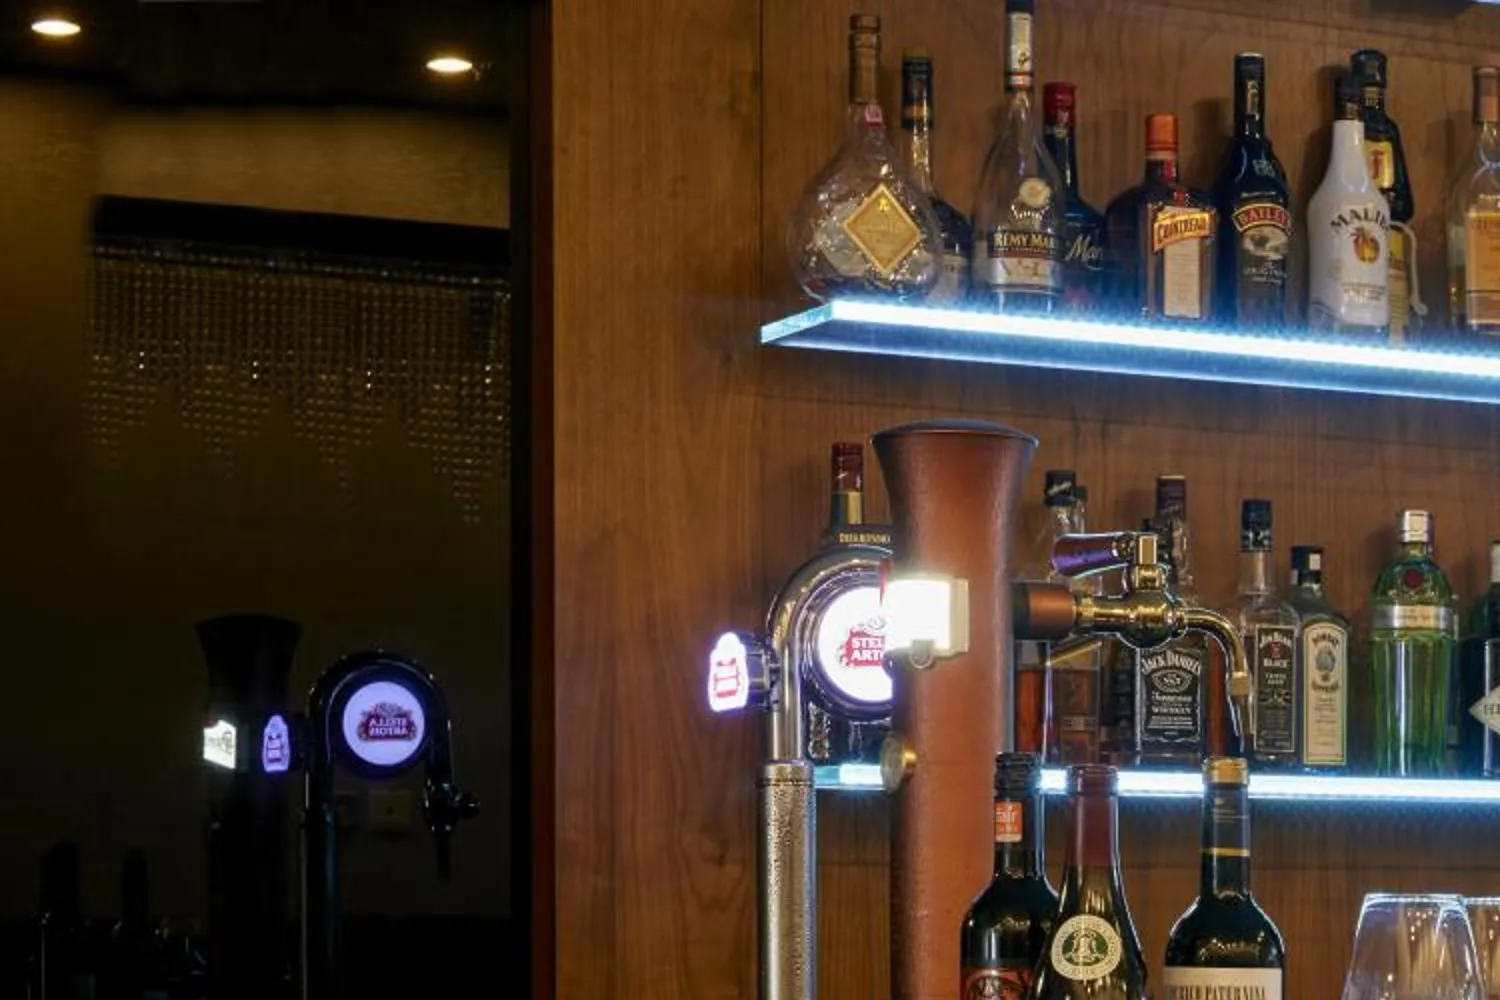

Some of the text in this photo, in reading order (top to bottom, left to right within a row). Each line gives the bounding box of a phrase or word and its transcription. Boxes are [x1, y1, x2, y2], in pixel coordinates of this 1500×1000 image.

[1238, 206, 1290, 230] BAILEY
[1329, 207, 1390, 234] MALIB
[851, 637, 885, 648] STEL
